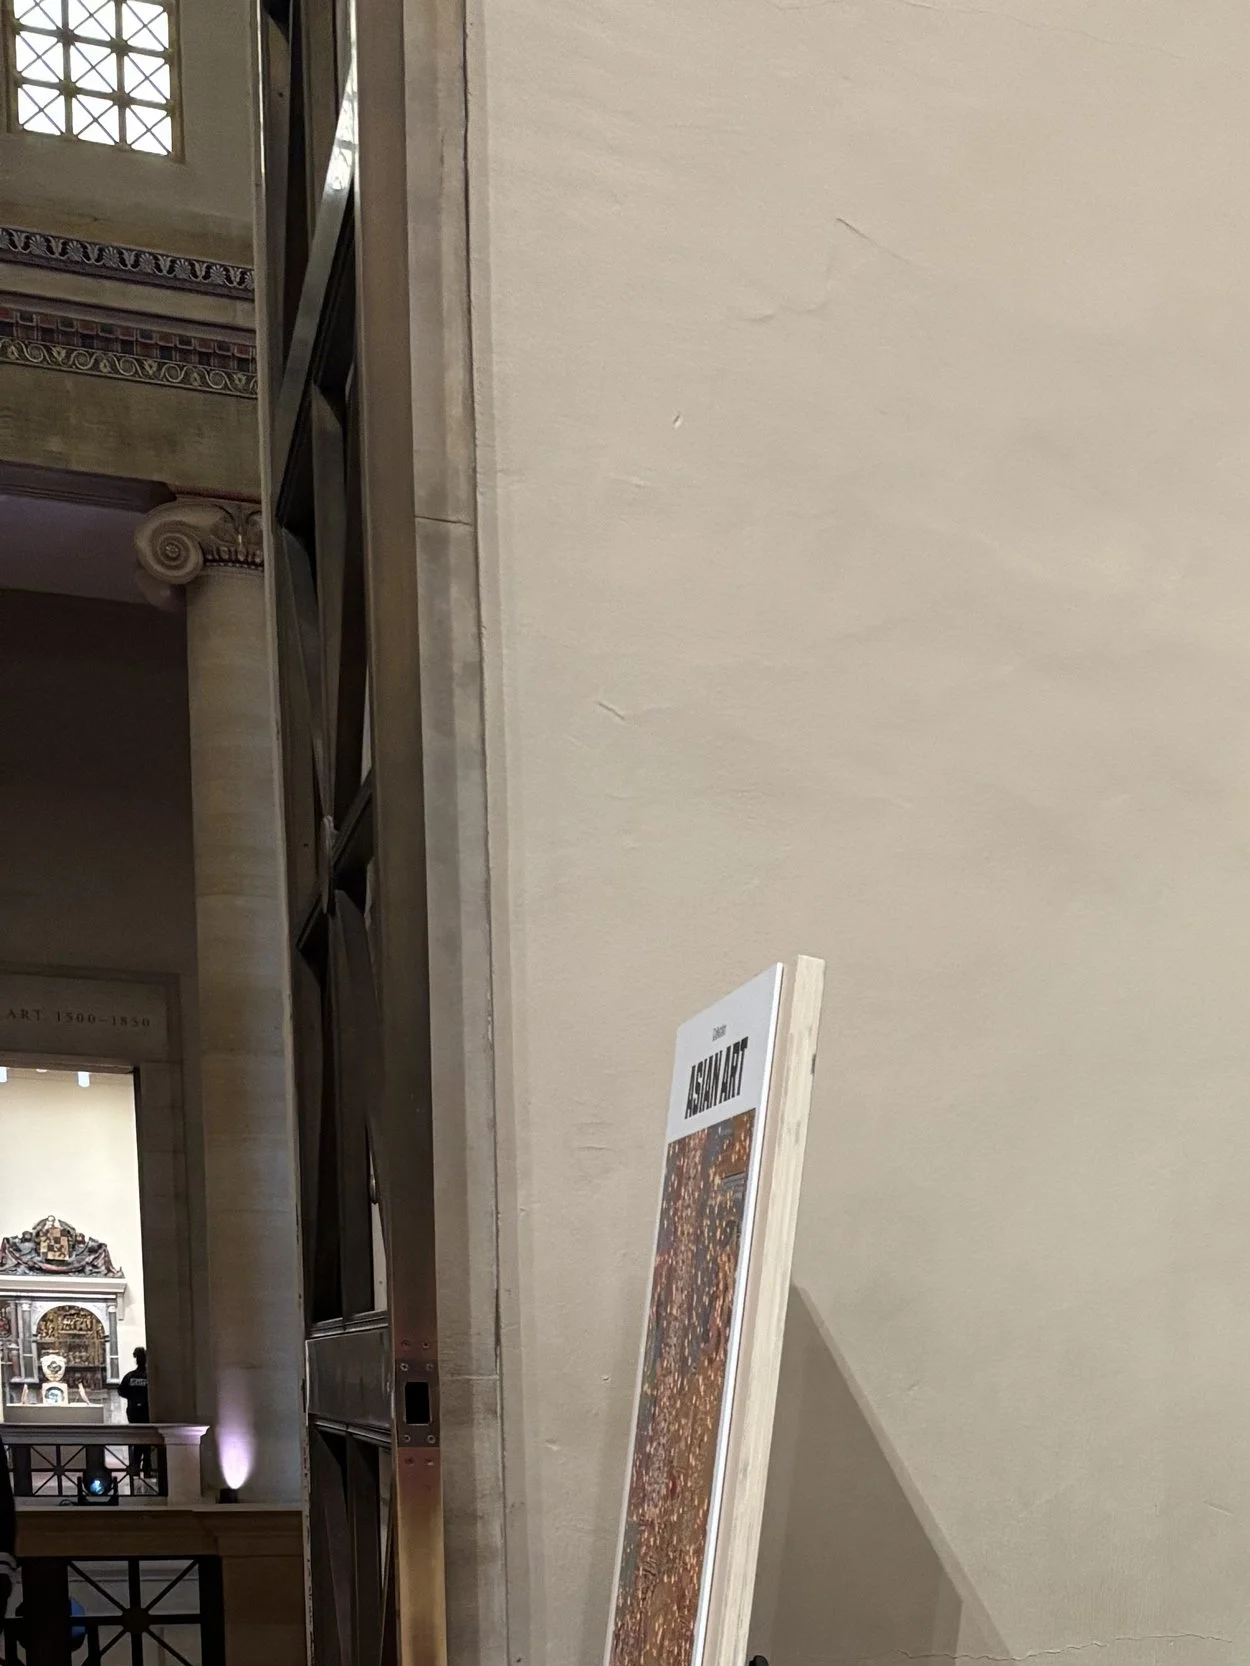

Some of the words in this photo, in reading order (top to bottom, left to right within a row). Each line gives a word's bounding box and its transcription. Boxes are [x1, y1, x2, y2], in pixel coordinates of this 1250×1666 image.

[7, 1008, 41, 1022] ART
[684, 1050, 723, 1119] ASIAN
[718, 1036, 749, 1104] ART
